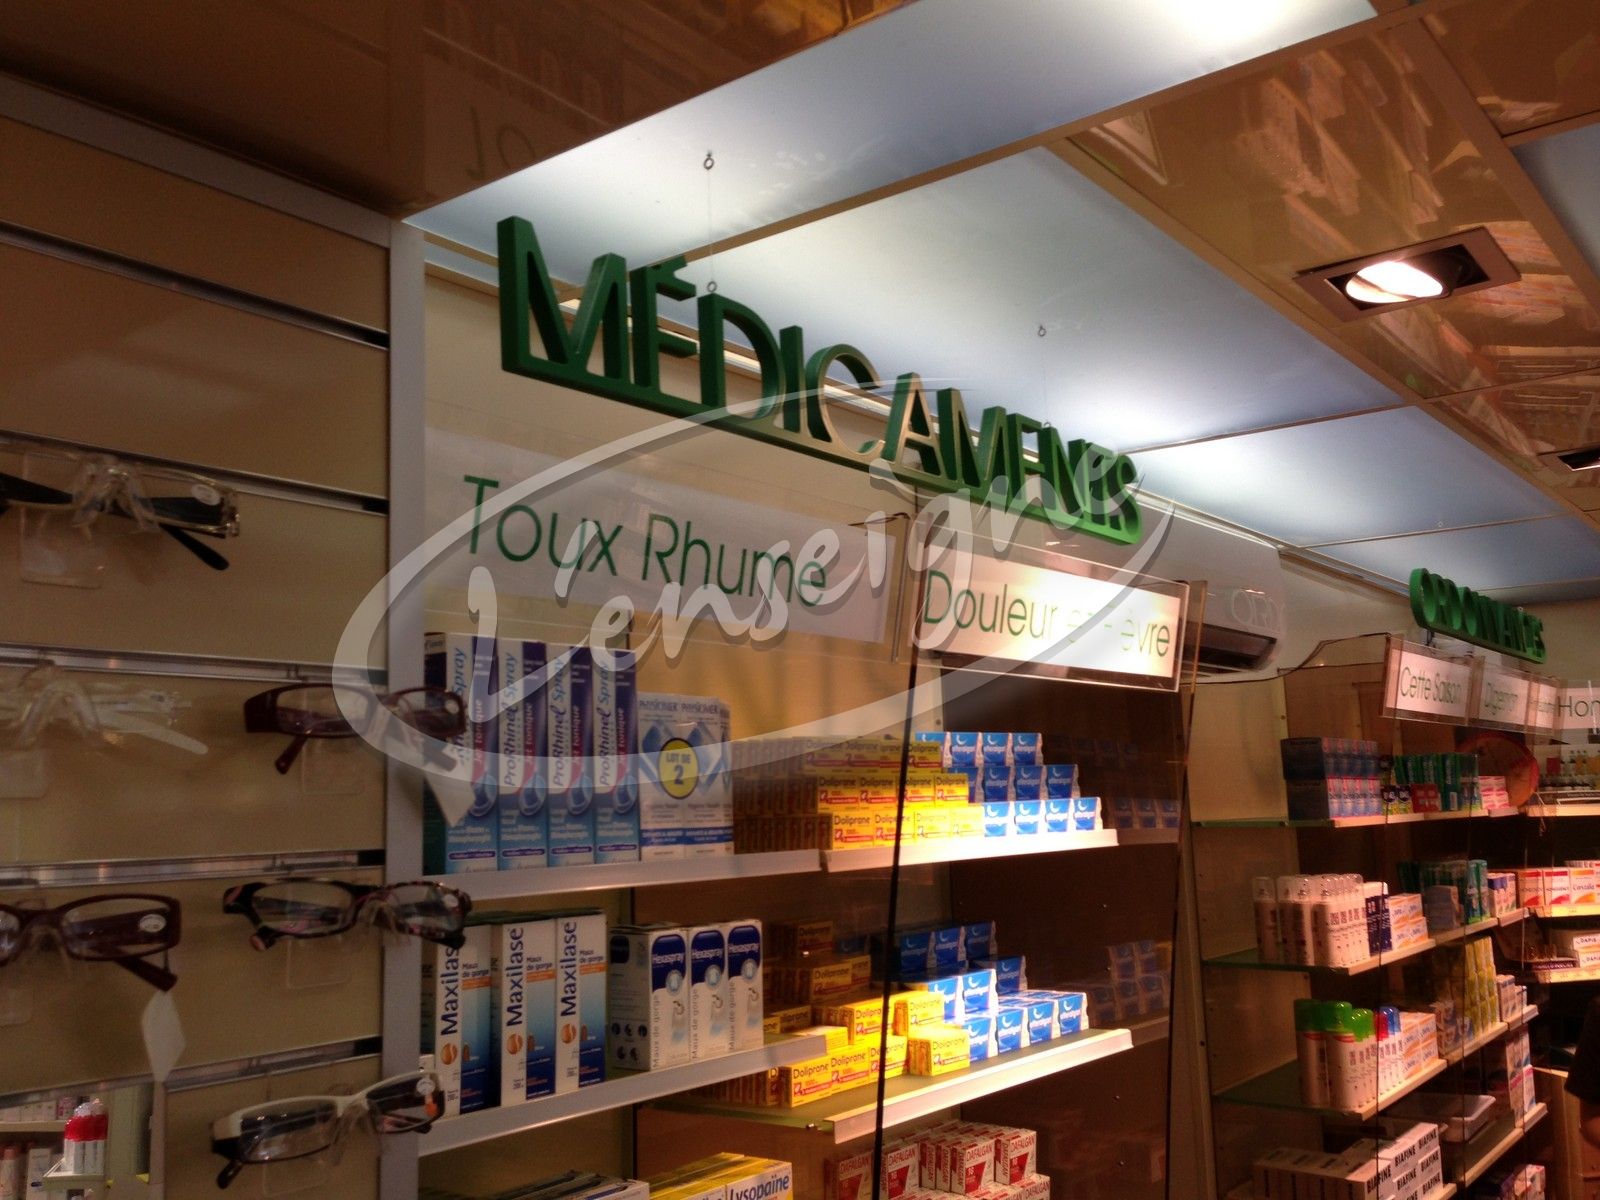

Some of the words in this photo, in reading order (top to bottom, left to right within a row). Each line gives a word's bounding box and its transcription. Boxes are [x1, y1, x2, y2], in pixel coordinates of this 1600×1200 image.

[463, 474, 623, 577] Toux
[641, 512, 827, 608] Rhume
[923, 569, 1058, 639] Douleur
[452, 648, 466, 695] Spray
[503, 652, 518, 698] Spray
[552, 657, 565, 702] Spray
[599, 661, 610, 705] Spray
[1400, 666, 1432, 699] Cette
[473, 699, 484, 743] tonique
[524, 703, 535, 745] tonique
[572, 705, 582, 747] tonique
[617, 706, 626, 748] tonique
[502, 704, 518, 786] ProRhinel
[551, 704, 567, 786] ProRhinel
[598, 706, 612, 786] ProRhinel
[666, 754, 679, 764] LOT
[680, 753, 692, 764] DE
[674, 764, 684, 785] 2
[906, 777, 932, 787] oliprane
[834, 815, 870, 827] Doliprane
[506, 928, 524, 1027] Maxilase
[560, 921, 577, 1017] Maxilase
[440, 947, 460, 1036] Maxilas
[855, 1006, 883, 1021] Dolipra
[793, 1062, 830, 1080] Doliprane
[831, 1051, 866, 1068] Doliprane
[888, 1147, 917, 1167] DAFALGAN
[967, 1142, 993, 1162] DAFALGAN
[1394, 1144, 1417, 1168] BIAFINE
[1418, 1128, 1438, 1150] BIAFINE
[1396, 1168, 1418, 1191] BIAFINE
[1420, 1150, 1440, 1173] BIAFINE
[729, 1174, 790, 1200] Lysopaïne
[1422, 1171, 1441, 1195] BIAFINE
